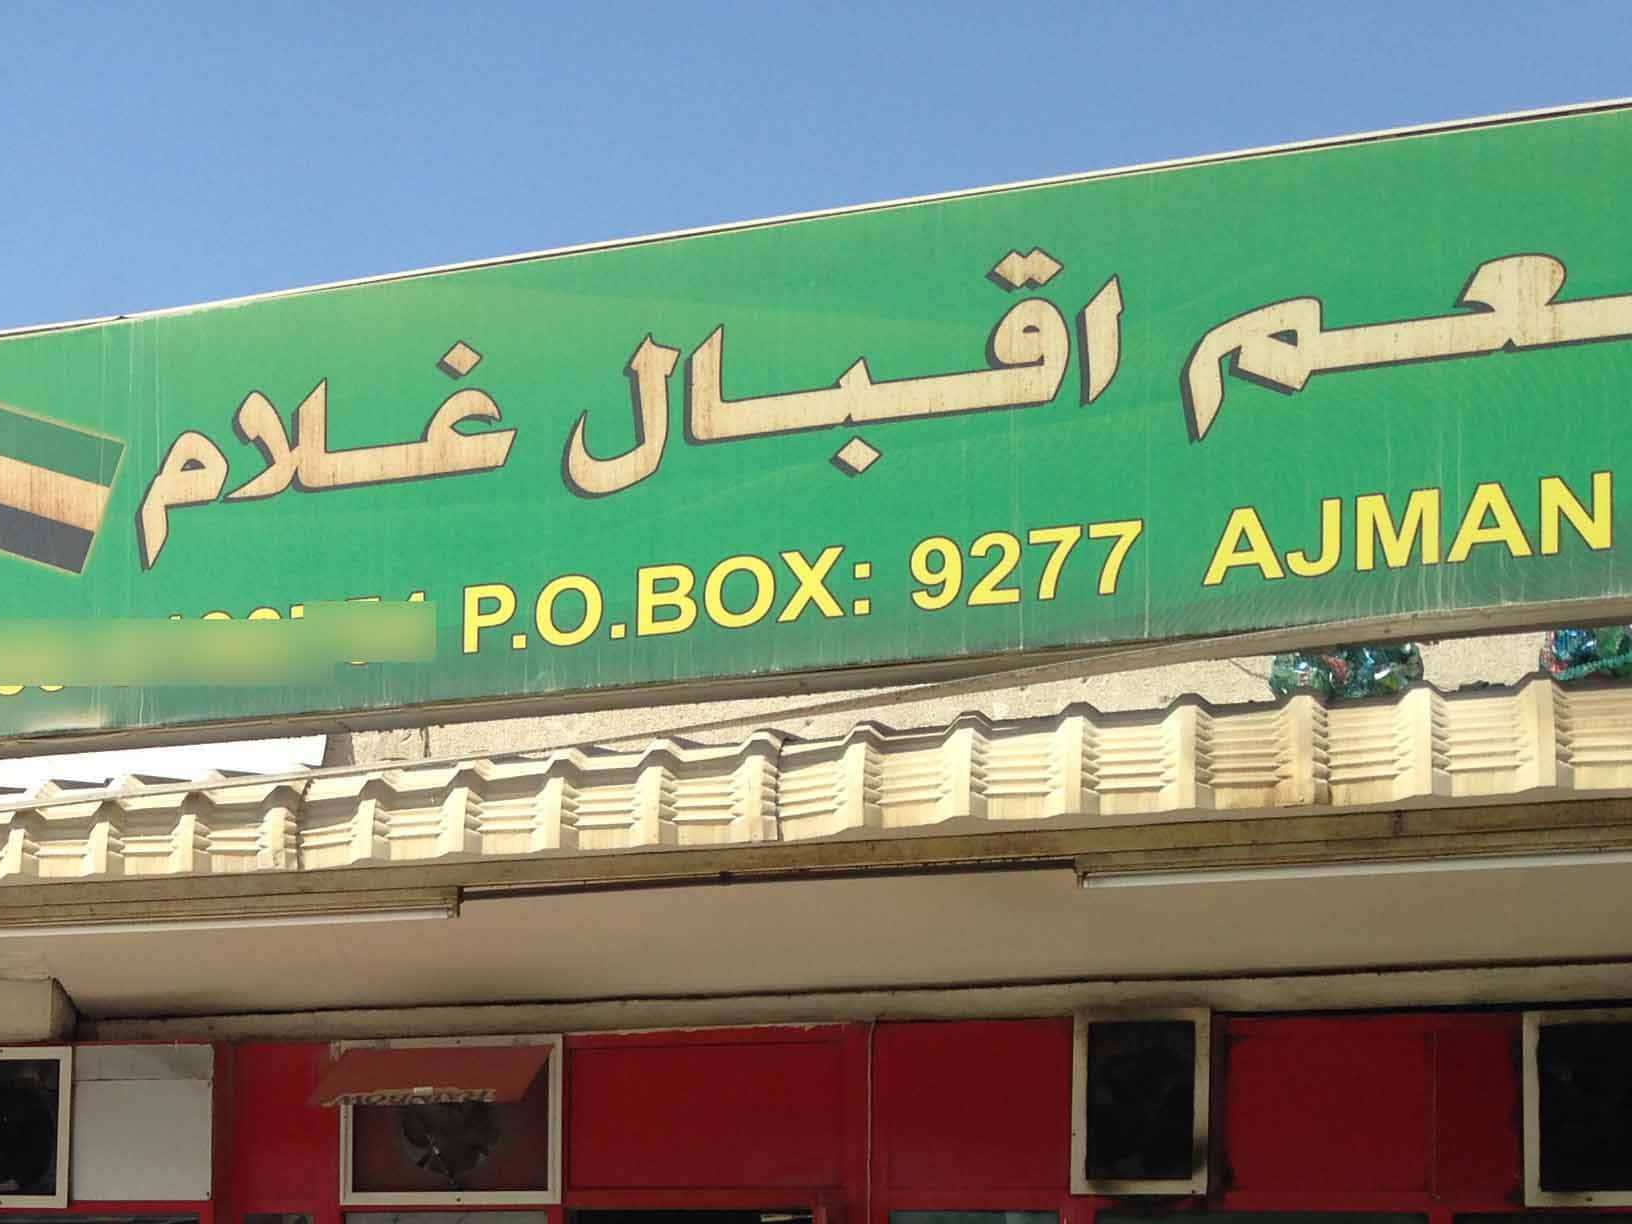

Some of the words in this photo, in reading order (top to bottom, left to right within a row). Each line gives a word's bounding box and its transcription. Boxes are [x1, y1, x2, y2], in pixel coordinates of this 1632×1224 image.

[136, 343, 519, 571] غلام
[562, 246, 1124, 497] اقبال
[462, 545, 872, 653] P.O.BOX:
[909, 519, 1143, 610] 9277
[1201, 471, 1613, 587] AJMAN
